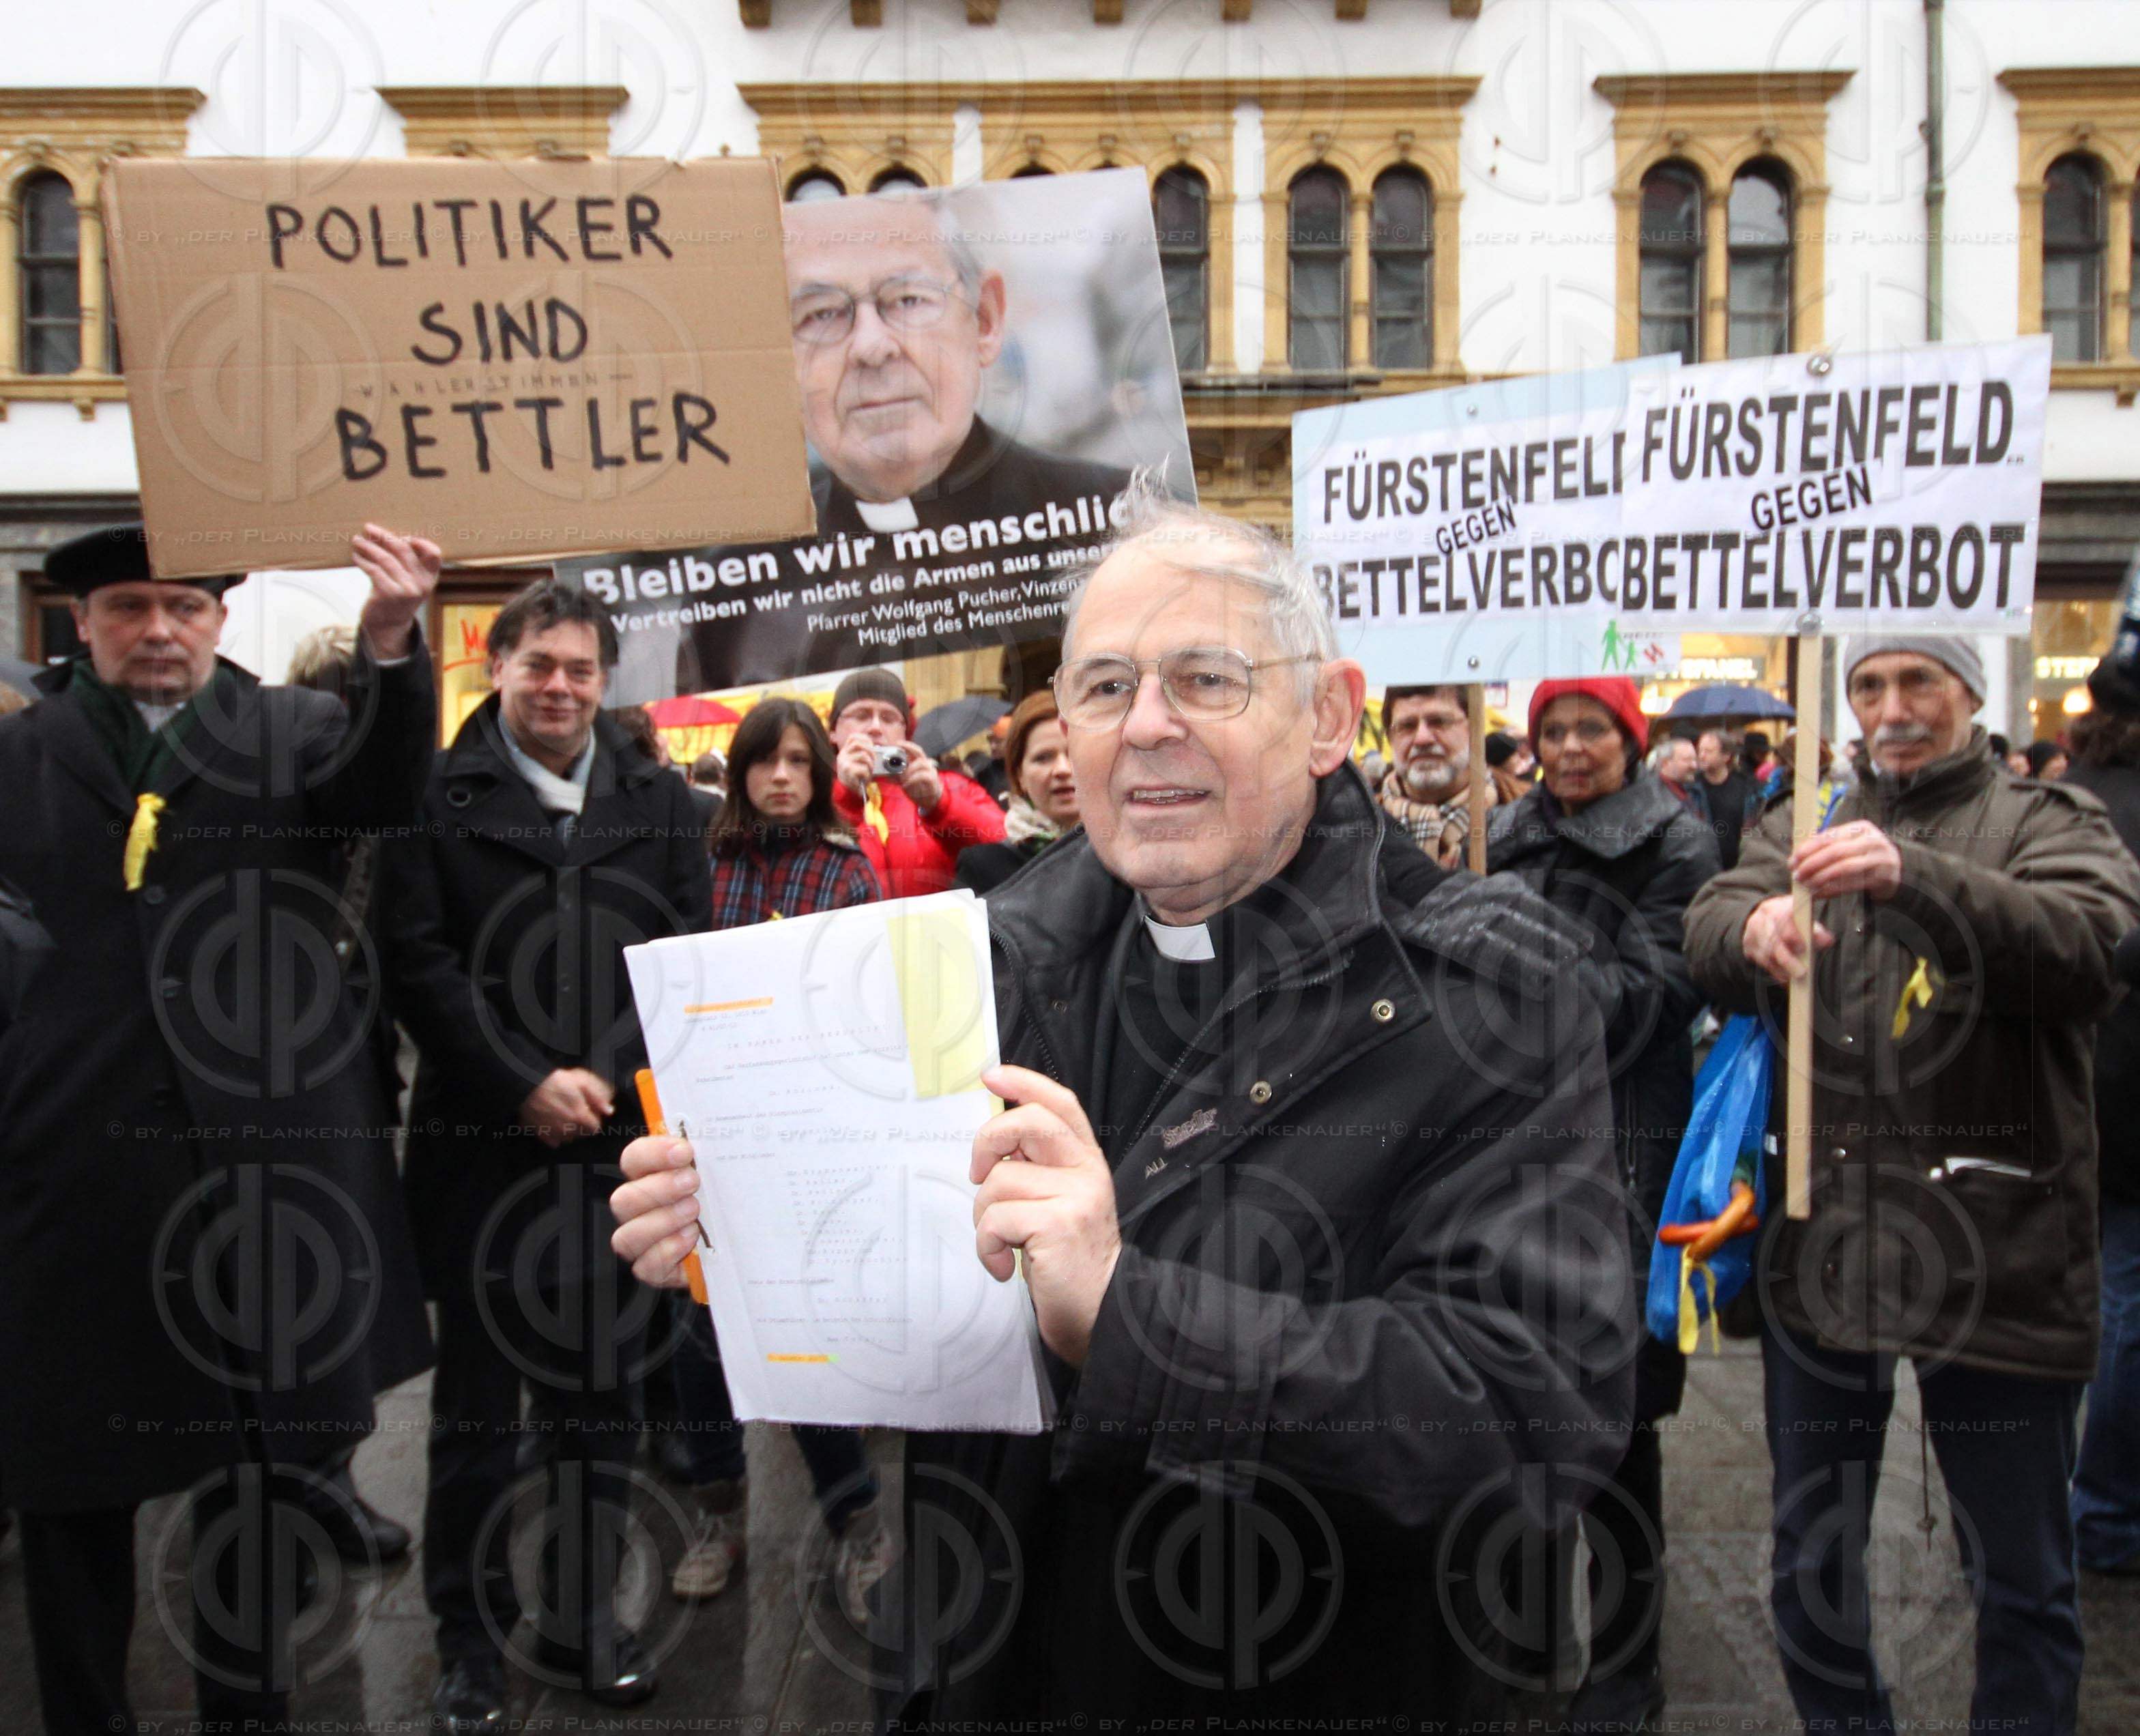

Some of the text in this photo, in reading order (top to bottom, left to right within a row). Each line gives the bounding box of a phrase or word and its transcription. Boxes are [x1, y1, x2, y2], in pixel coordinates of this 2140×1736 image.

[267, 194, 674, 269] POLITIKER
[411, 297, 588, 364] SIND
[335, 392, 730, 480] BETTLER
[1642, 378, 2014, 482] FÜRSTENFELD
[1435, 500, 1517, 557] GEGEN
[1751, 466, 1873, 531] GEGEN
[583, 551, 779, 605] Bleiben
[794, 532, 875, 575] wir
[610, 598, 747, 634] Vertreiben
[753, 590, 794, 612] wir
[801, 579, 862, 605] nicht
[869, 573, 906, 595] die
[913, 561, 995, 588] Armen
[1002, 552, 1041, 575] aus
[1621, 521, 2026, 611] BETTELVERBOT
[807, 607, 869, 633] Pfarrer
[871, 596, 954, 622] Wolfgang
[858, 621, 927, 647] Mitglied
[934, 616, 962, 635] des
